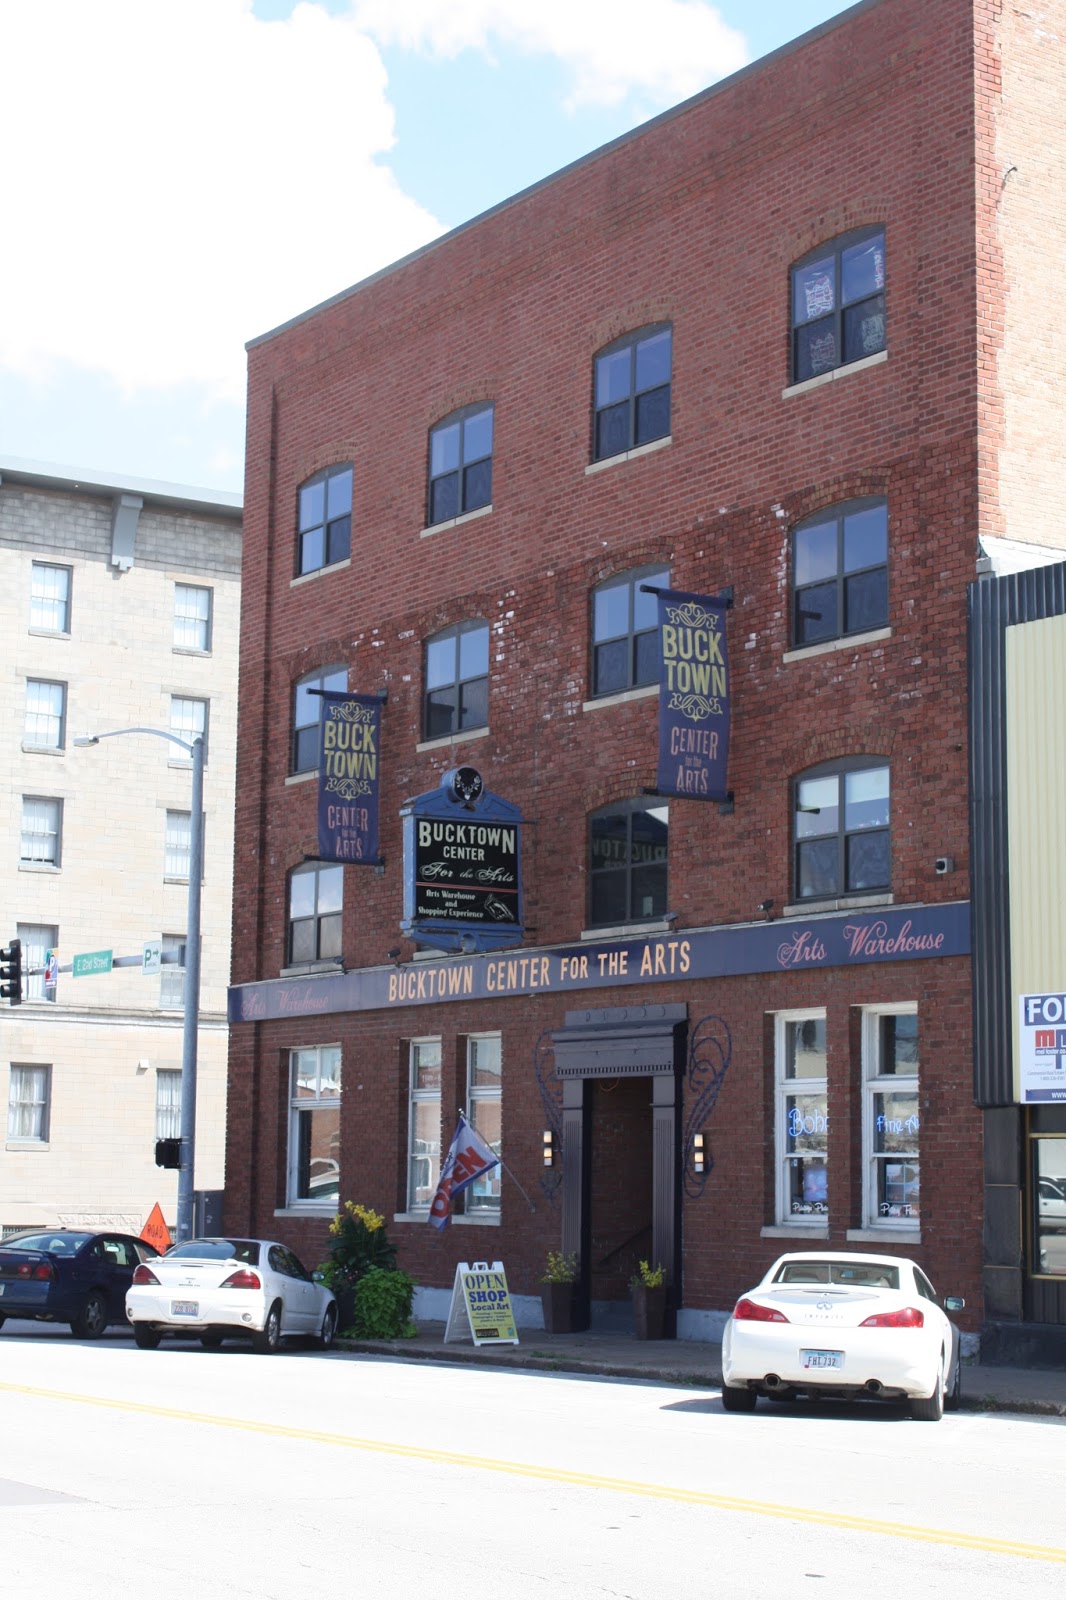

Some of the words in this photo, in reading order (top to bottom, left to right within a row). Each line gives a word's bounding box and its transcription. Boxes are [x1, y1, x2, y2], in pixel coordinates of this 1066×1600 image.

[662, 624, 724, 665] BUCK
[663, 659, 727, 698] TOWN
[324, 720, 376, 754] BUCK
[671, 726, 718, 760] CENTER
[324, 750, 377, 780] TOWN
[676, 765, 708, 794] ARTS
[327, 805, 368, 832] CENTER
[336, 836, 363, 859] ARTS
[419, 821, 515, 854] BUCKTOWN
[443, 846, 485, 861] CENTER
[420, 862, 453, 881] For
[460, 868, 473, 879] the
[475, 866, 514, 884] Arts
[426, 889, 440, 898] Arts
[441, 890, 476, 900] Warehouse
[418, 906, 448, 917] Shopping
[449, 908, 484, 918] Experience
[777, 931, 827, 968] Arts
[843, 920, 944, 957] Warehouse
[77, 959, 81, 972] E
[82, 959, 92, 971] 2nd
[93, 956, 109, 969] Street
[388, 965, 473, 1001] BUCKTOWN
[487, 957, 550, 991] CENTER
[560, 955, 589, 981] FOR
[598, 951, 628, 977] THE
[640, 940, 691, 976] ARTS
[241, 993, 266, 1018] Arts
[278, 987, 328, 1011] Warehouse
[1028, 997, 1066, 1023] FO
[147, 1224, 163, 1238] ROAD
[465, 1274, 504, 1289] OPEN
[469, 1290, 507, 1303] SHOP
[471, 1303, 495, 1311] Local
[823, 1357, 836, 1366] 732
